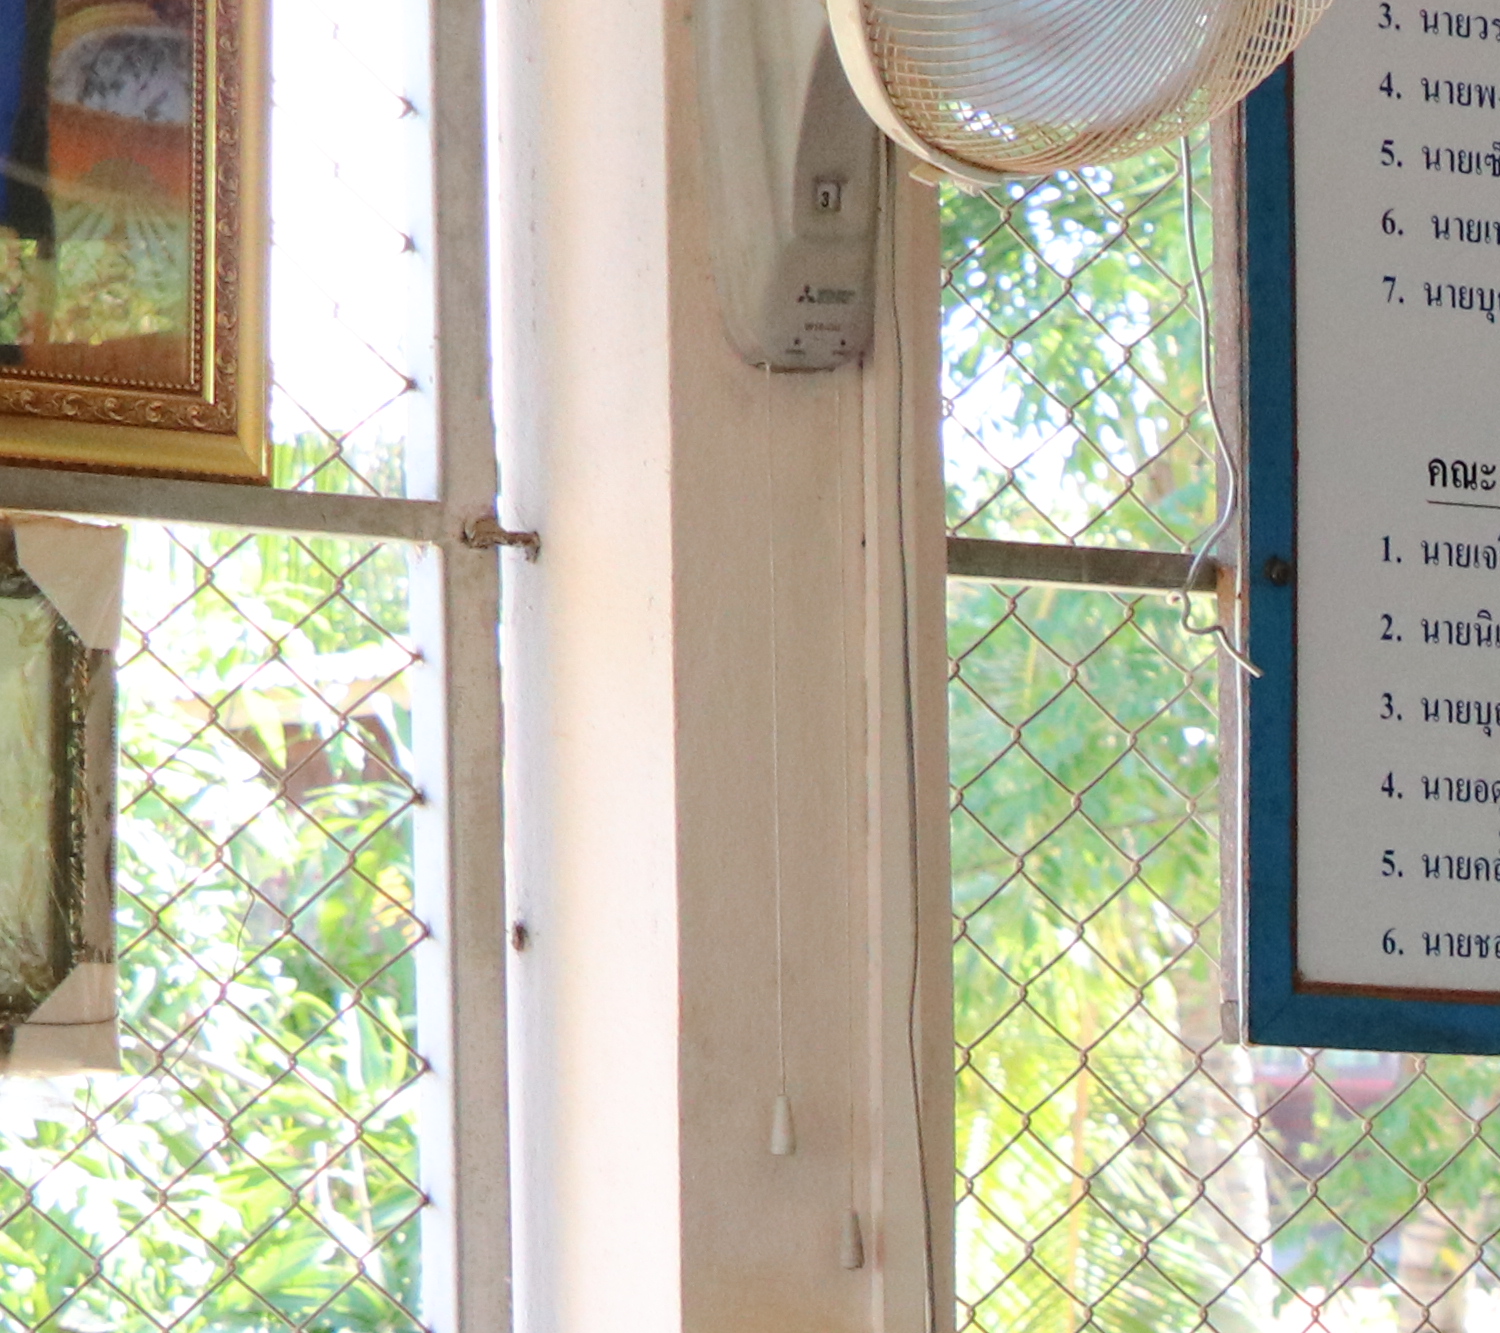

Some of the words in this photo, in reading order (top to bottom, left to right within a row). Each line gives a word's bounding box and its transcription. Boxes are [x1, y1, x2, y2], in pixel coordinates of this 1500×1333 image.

[1378, 1, 1401, 31] 3.
[1378, 71, 1402, 100] 4.
[1380, 139, 1403, 168] 5.
[820, 190, 830, 208] 3
[1381, 208, 1404, 236] 6.
[1382, 275, 1405, 304] 7.
[1382, 535, 1402, 564] 1.
[1380, 613, 1402, 642] 2.
[1380, 692, 1403, 721] 3.
[1380, 771, 1403, 800] 4.
[1381, 849, 1404, 878] 5.
[1381, 928, 1404, 956] 6.
